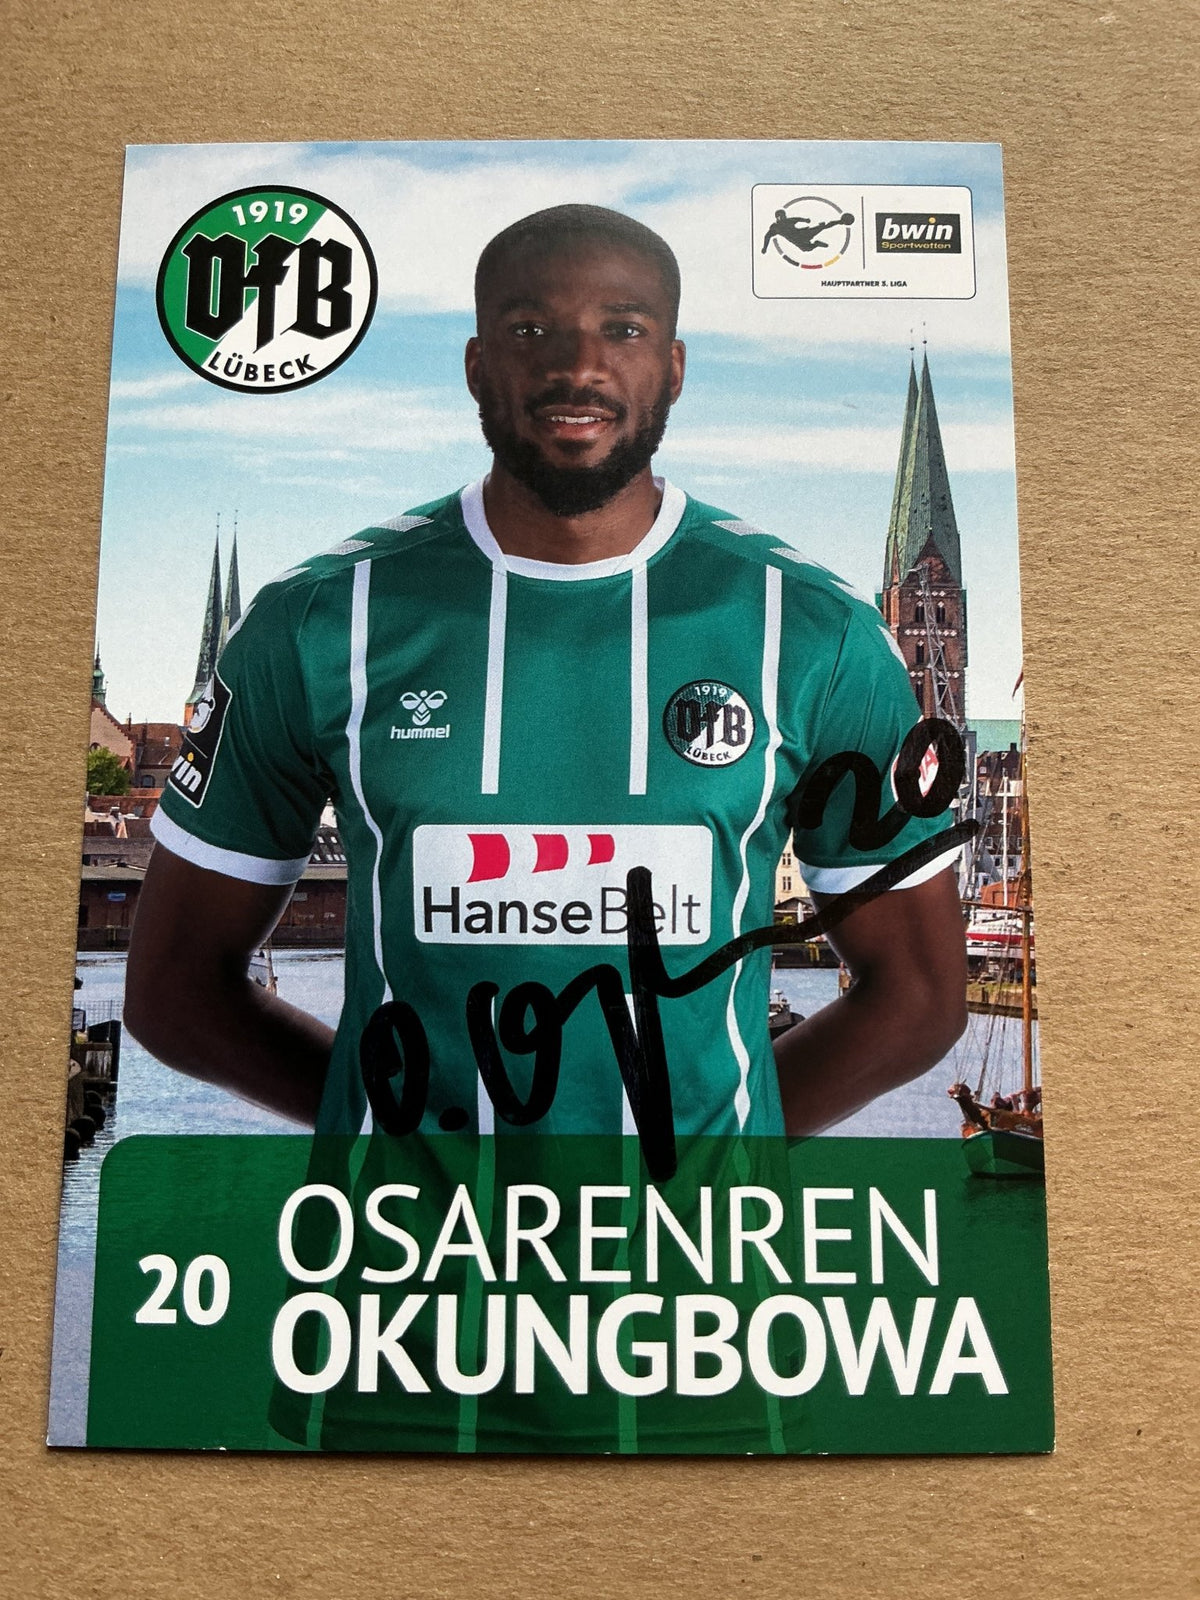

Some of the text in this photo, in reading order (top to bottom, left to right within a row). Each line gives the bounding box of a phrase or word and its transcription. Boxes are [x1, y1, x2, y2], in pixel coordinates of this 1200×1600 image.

[232, 200, 308, 226] 1919
[881, 216, 954, 241] bwin
[880, 241, 952, 250] Sportwetten
[182, 232, 352, 354] VfB
[820, 280, 880, 288] HAUPTPARTNER
[890, 280, 908, 288] LIGA
[207, 350, 318, 383] LÜBECK
[694, 685, 728, 698] 1919
[390, 725, 451, 740] hummel
[674, 698, 747, 750] VfB
[686, 746, 732, 762] LÜBECK
[278, 1182, 939, 1287] OSARENREN
[135, 1254, 231, 1326] 20
[271, 1292, 1009, 1397] OKUNGBOWA
